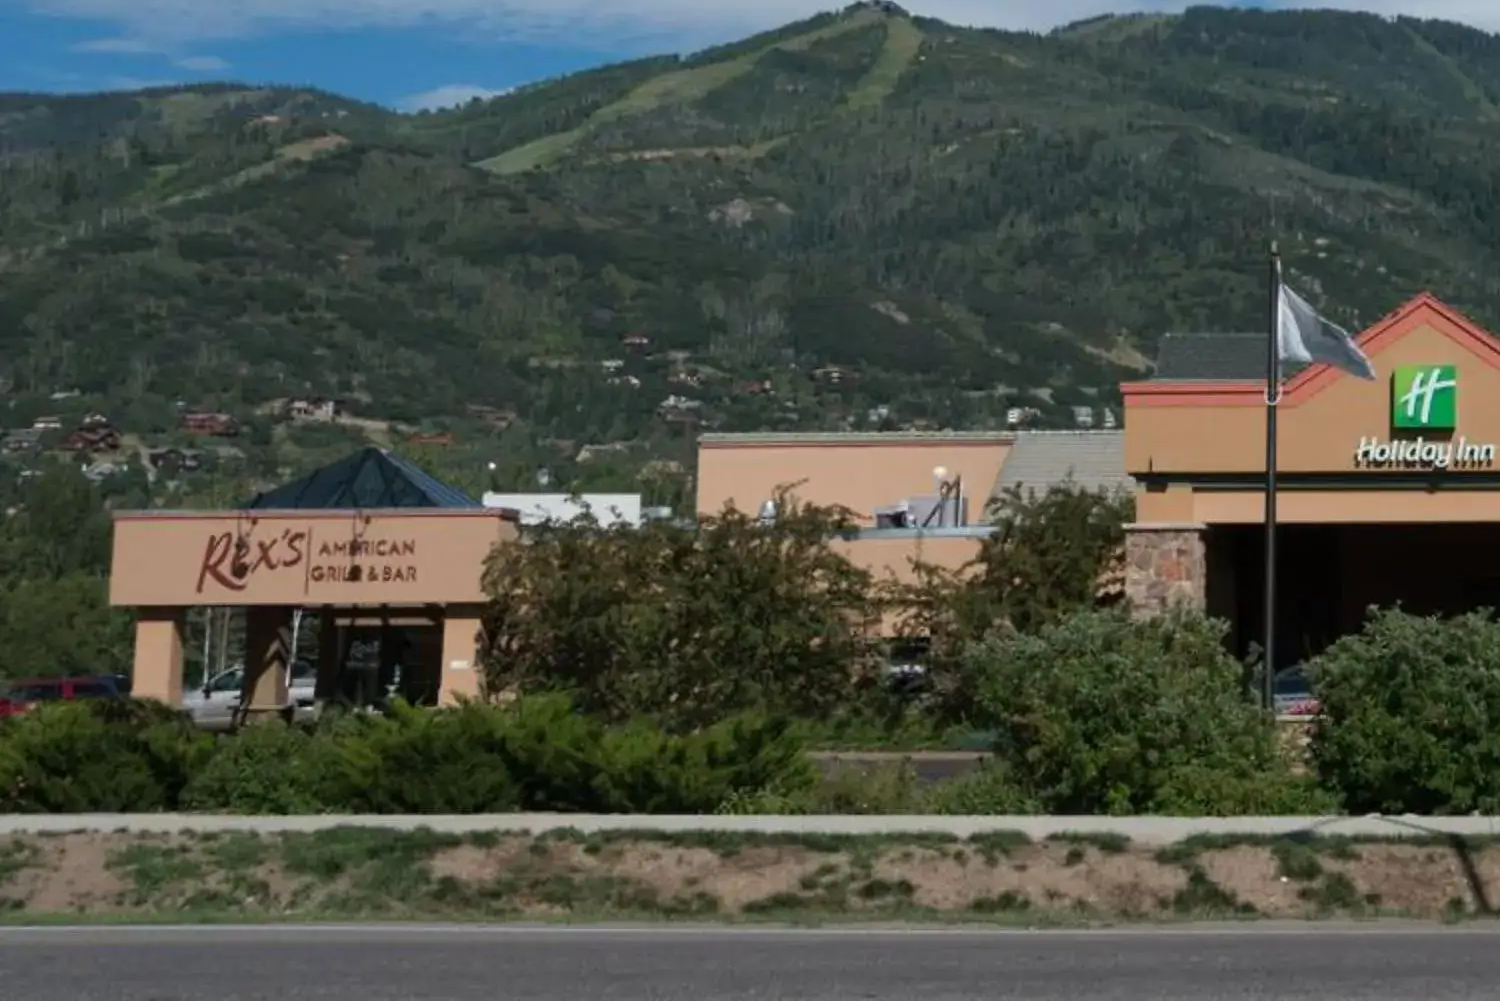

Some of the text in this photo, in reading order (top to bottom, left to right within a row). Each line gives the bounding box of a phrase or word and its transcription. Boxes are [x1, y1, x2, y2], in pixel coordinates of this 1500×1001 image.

[1356, 436, 1496, 467] Holiday Inn
[311, 565, 417, 582] GRIL & BAR
